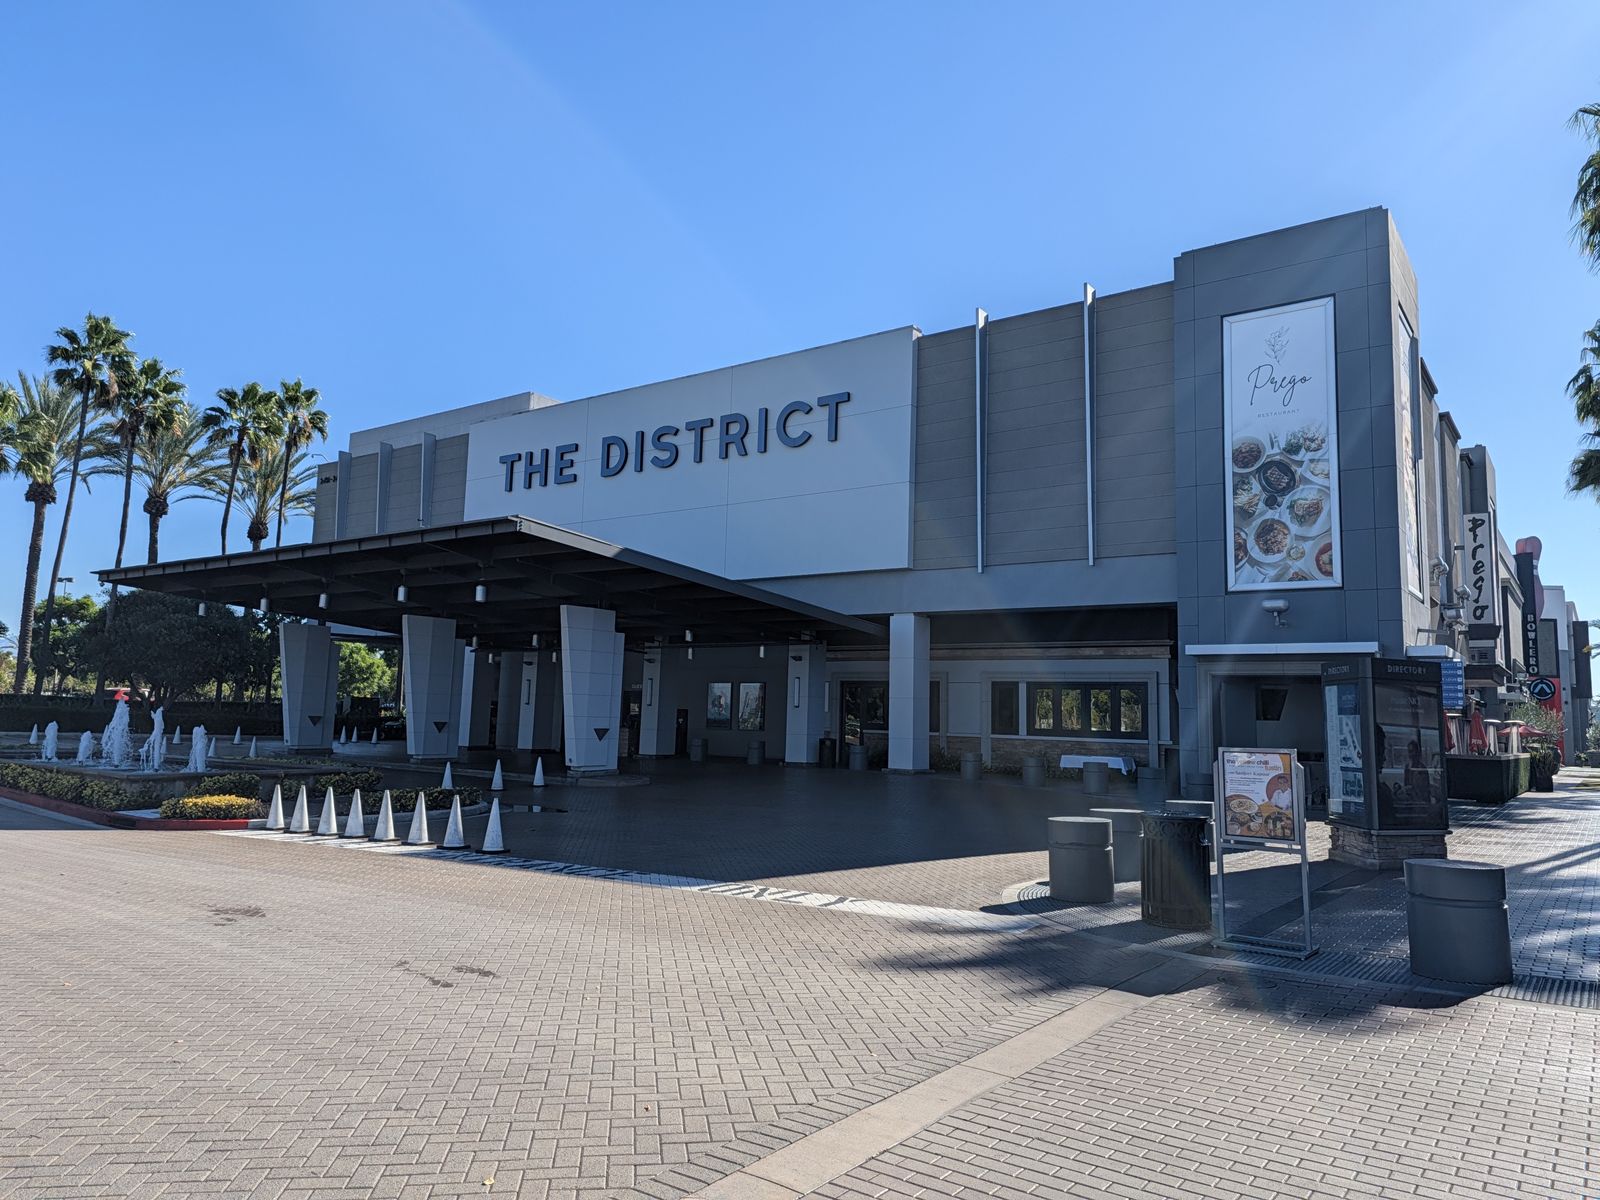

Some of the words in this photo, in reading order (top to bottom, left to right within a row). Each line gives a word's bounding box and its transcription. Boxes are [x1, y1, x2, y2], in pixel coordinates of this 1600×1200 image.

[1248, 364, 1312, 407] Prego
[1257, 409, 1300, 418] RESTAURANT
[499, 443, 579, 492] THE
[601, 391, 850, 478] DISTRICT
[1527, 614, 1539, 674] BOWLERO
[1387, 664, 1427, 675] DIRECTORY
